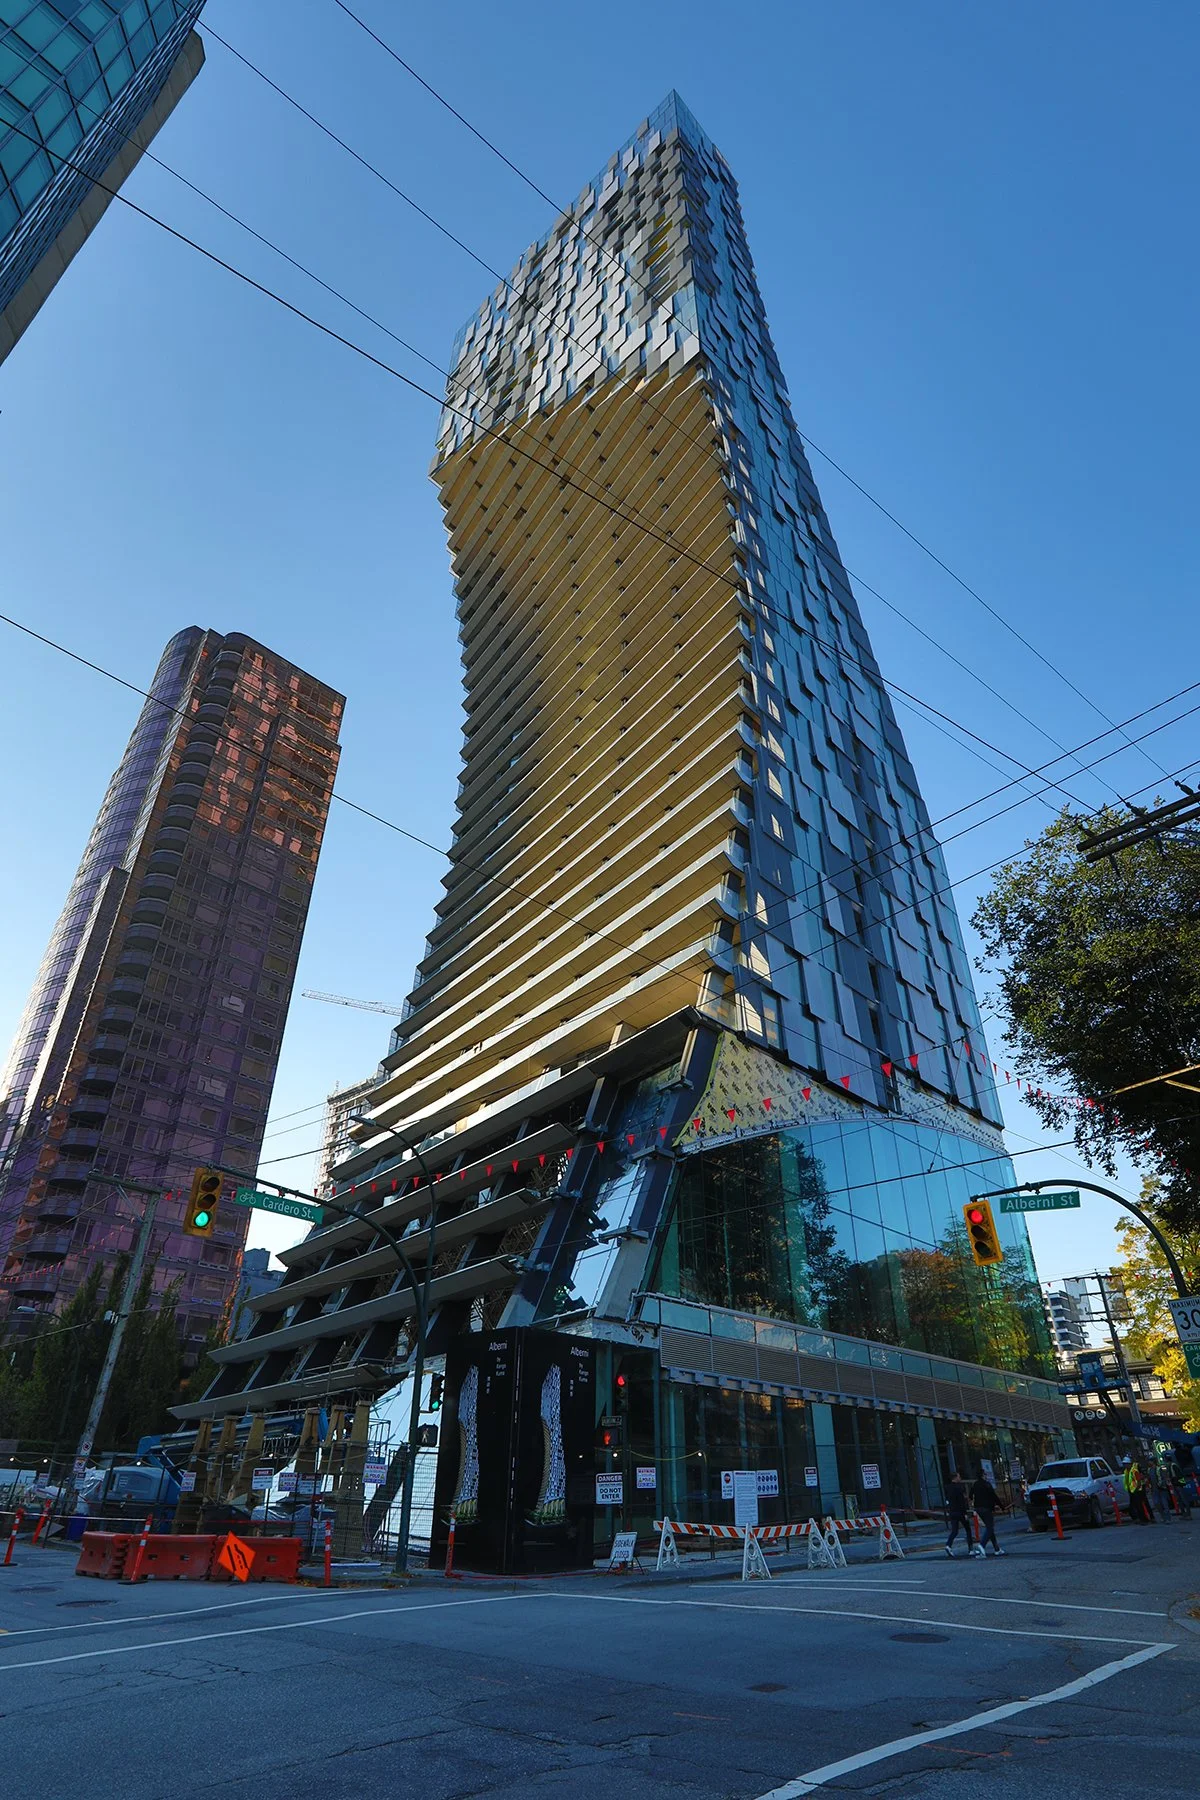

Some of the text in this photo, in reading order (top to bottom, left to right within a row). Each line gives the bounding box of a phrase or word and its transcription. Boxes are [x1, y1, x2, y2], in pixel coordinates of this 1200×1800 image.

[262, 1197, 314, 1219] Cardero St.
[1006, 1194, 1075, 1210] Alberni St
[1178, 1309, 1200, 1330] 30
[488, 1340, 508, 1351] Alberni
[570, 1346, 589, 1358] Alberni
